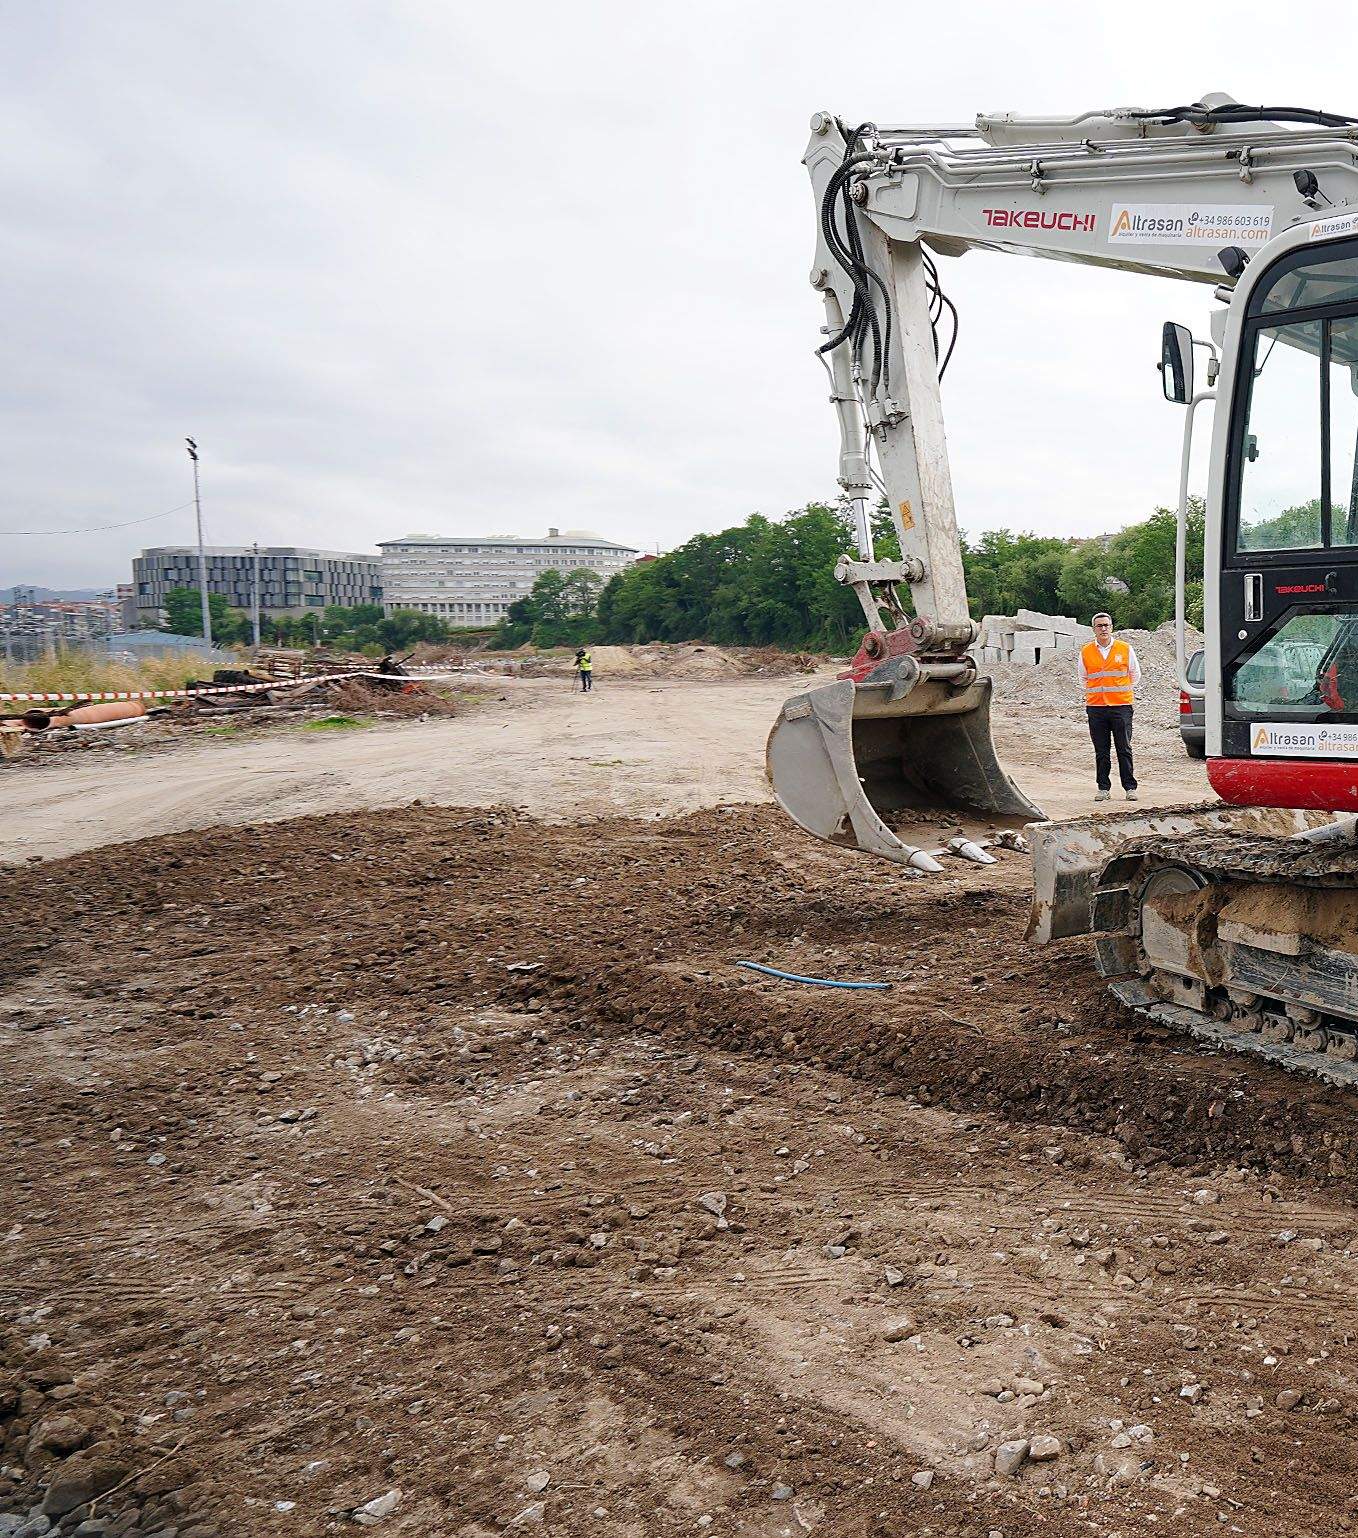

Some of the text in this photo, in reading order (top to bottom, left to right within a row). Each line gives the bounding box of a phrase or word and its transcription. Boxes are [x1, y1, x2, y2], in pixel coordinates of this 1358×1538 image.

[982, 209, 1096, 232] TAKEUCHI
[1112, 210, 1183, 236] Altrasan
[1199, 215, 1270, 226] +34 986 603 619
[1186, 226, 1268, 240] altrasan.com
[1311, 221, 1351, 237] Altrasan
[1253, 728, 1315, 748] Altrasan
[1328, 733, 1342, 741] +34
[1343, 733, 1358, 741] 986
